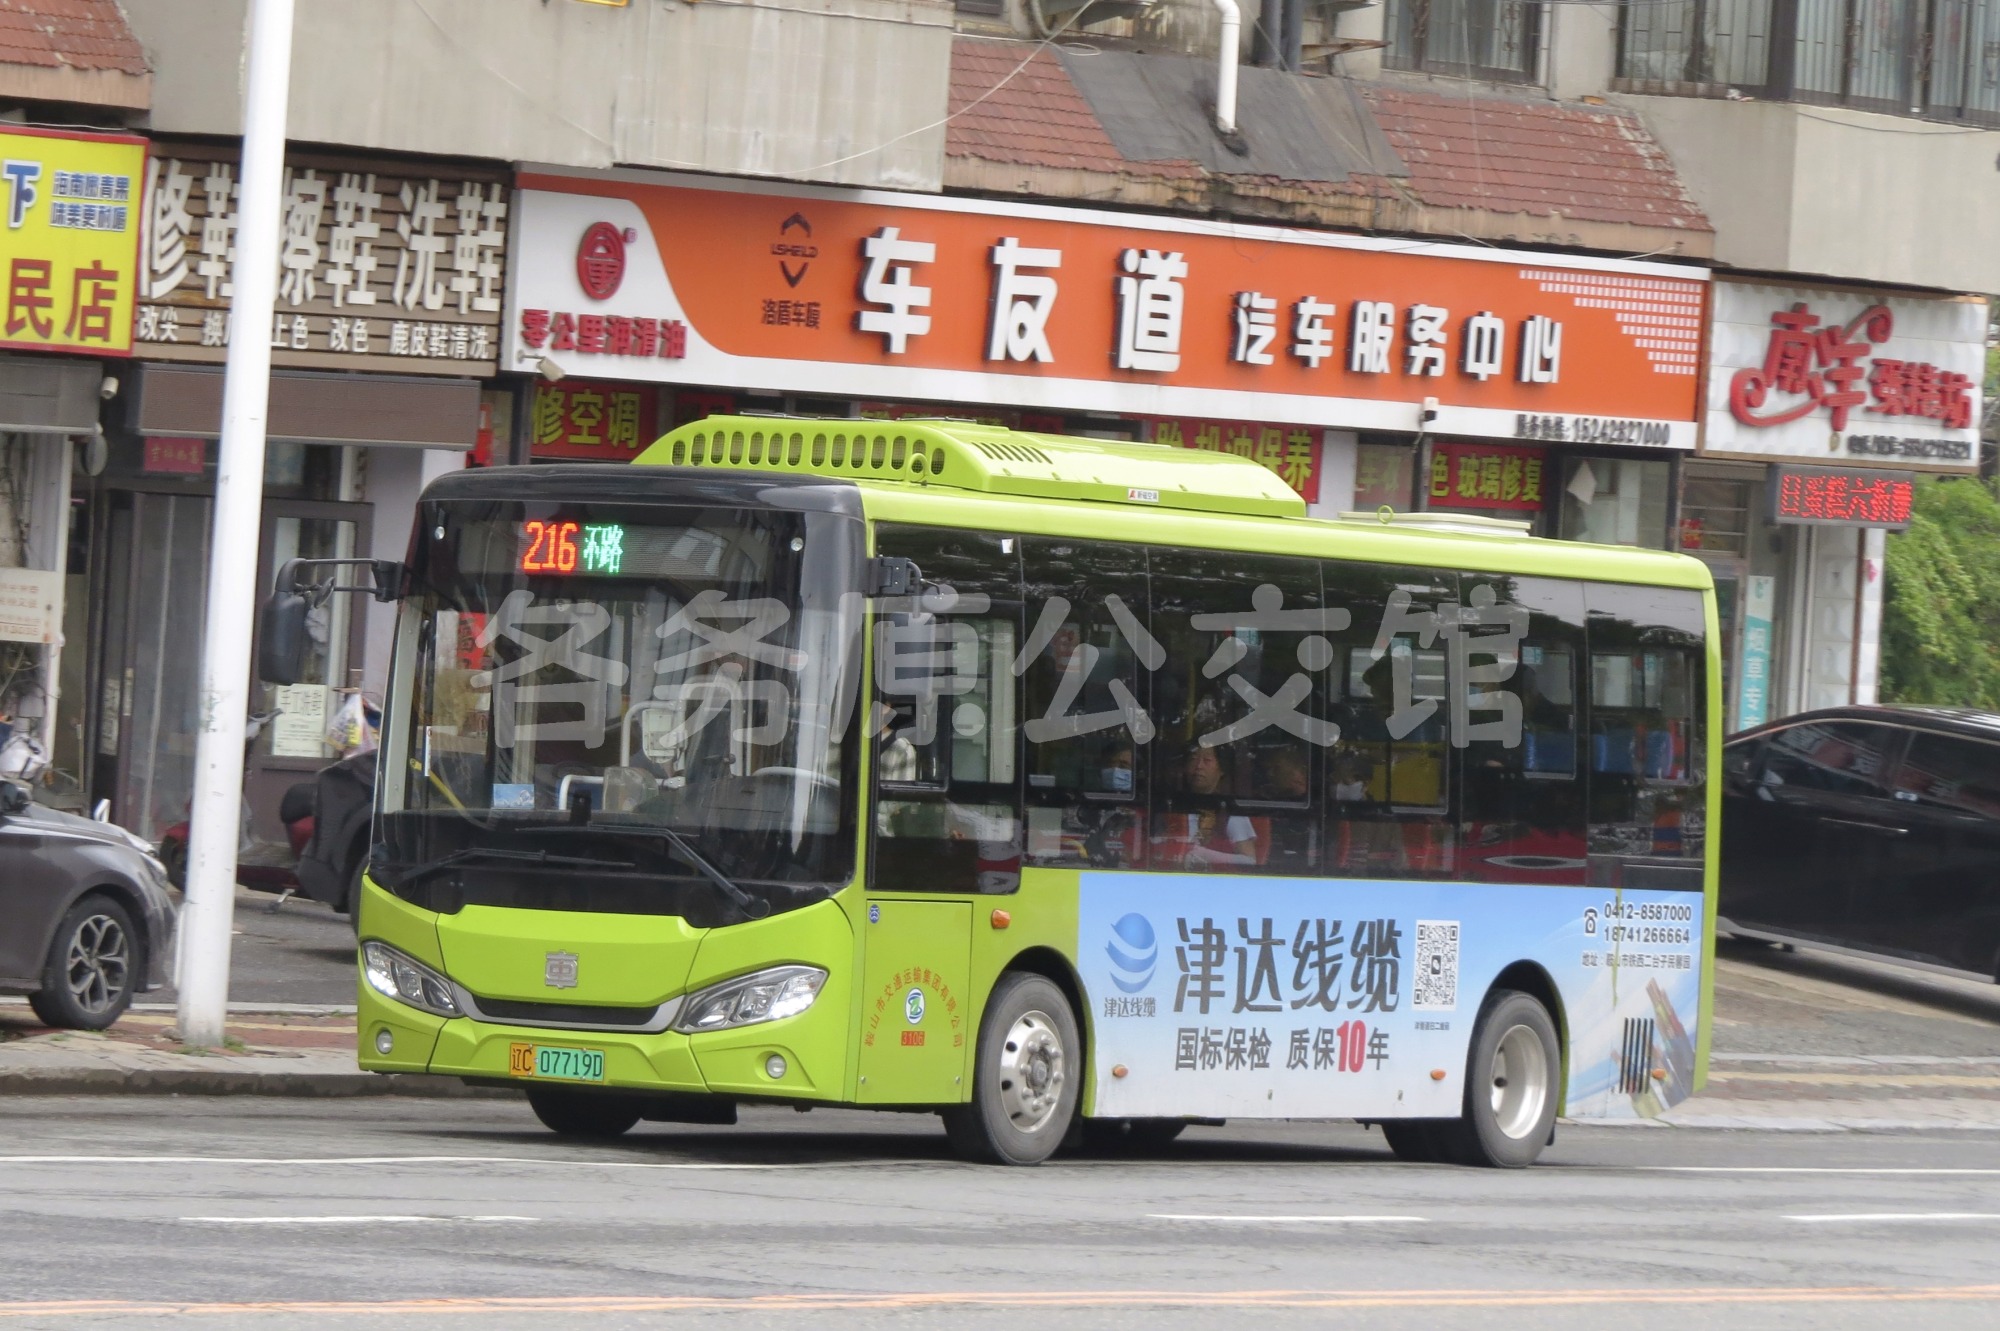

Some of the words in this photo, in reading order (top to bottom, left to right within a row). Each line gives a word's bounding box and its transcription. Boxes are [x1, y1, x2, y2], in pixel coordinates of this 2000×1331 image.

[5, 258, 119, 342] 民店
[858, 227, 1188, 373] 车友道
[1233, 291, 1562, 385] 汽车服务中心
[139, 305, 179, 341] 改尖
[271, 313, 309, 349] 上色
[330, 318, 369, 352] 改色
[389, 320, 489, 359] 鹿皮鞋清洗
[521, 309, 687, 359] 零公里润滑油
[532, 386, 641, 450] 修空调
[1456, 453, 1542, 502] 玻璃修复
[523, 520, 578, 572] 216
[1604, 902, 1692, 921] 0412-8587000
[1604, 926, 1690, 943] 18741266664
[1173, 917, 1402, 1015] 津达线缆
[1103, 997, 1157, 1019] 津达线缆
[511, 1047, 532, 1072] 辽C
[540, 1050, 603, 1078] 07719D
[1175, 1026, 1272, 1072] 国标保检
[1286, 1019, 1390, 1074] 质保10年
